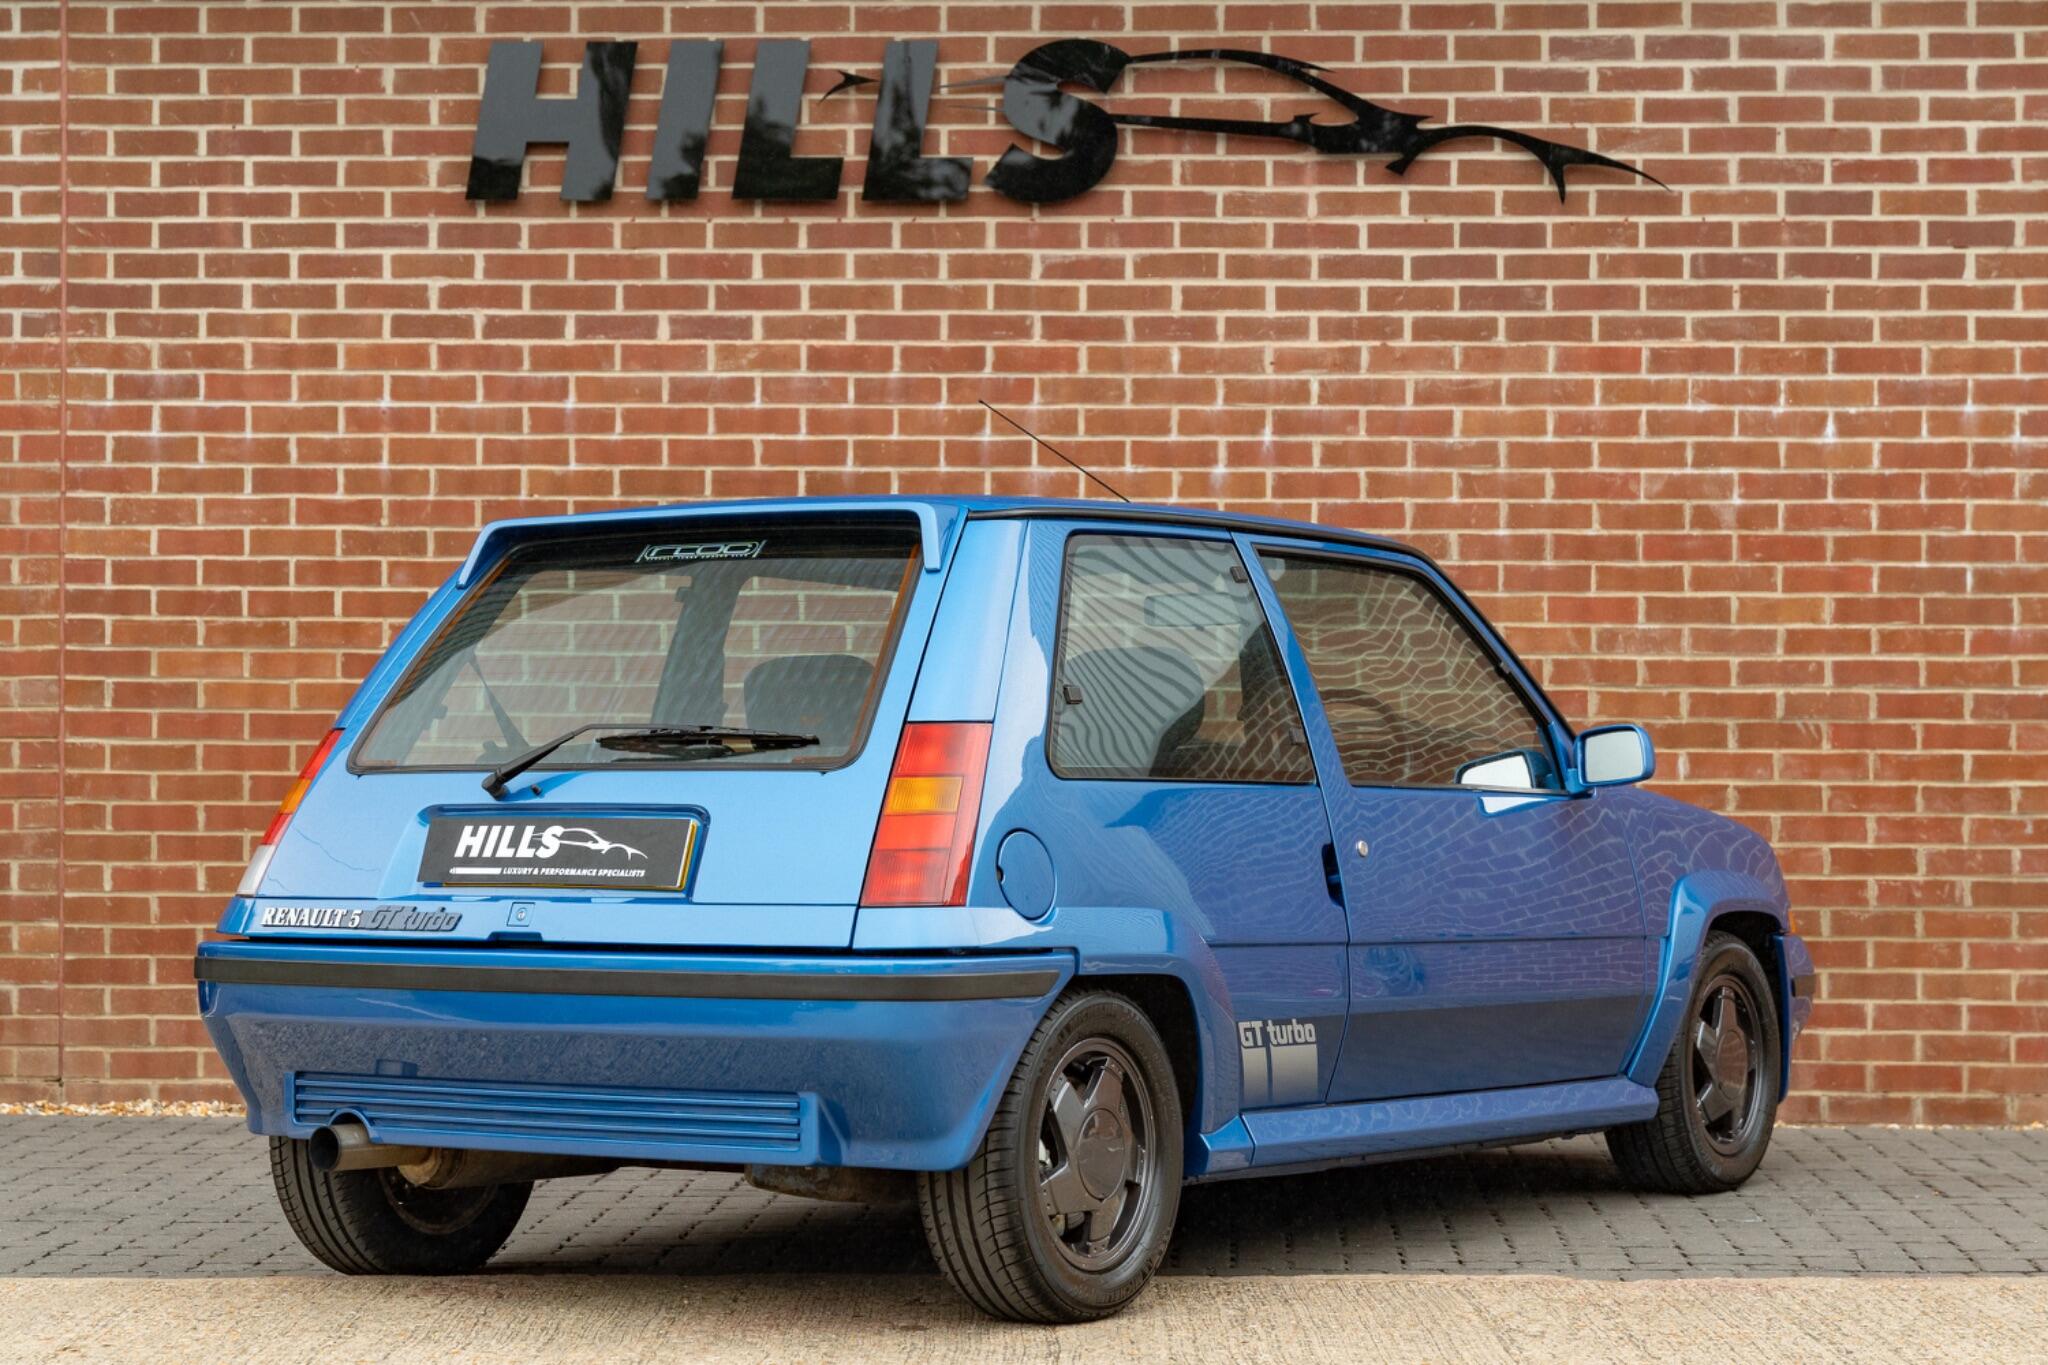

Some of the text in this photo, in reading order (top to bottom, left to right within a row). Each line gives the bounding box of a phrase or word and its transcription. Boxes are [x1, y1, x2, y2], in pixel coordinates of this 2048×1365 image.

[465, 37, 1131, 203] HILLS
[454, 825, 565, 859] HILLS
[502, 867, 533, 876] LUXURY
[540, 867, 597, 876] PERFORMANCE
[597, 868, 646, 878] SPECIALISTS
[260, 906, 347, 927] RENAULT
[348, 909, 363, 928] 5
[366, 904, 406, 929] GT
[1238, 1018, 1317, 1047] GT turbo
